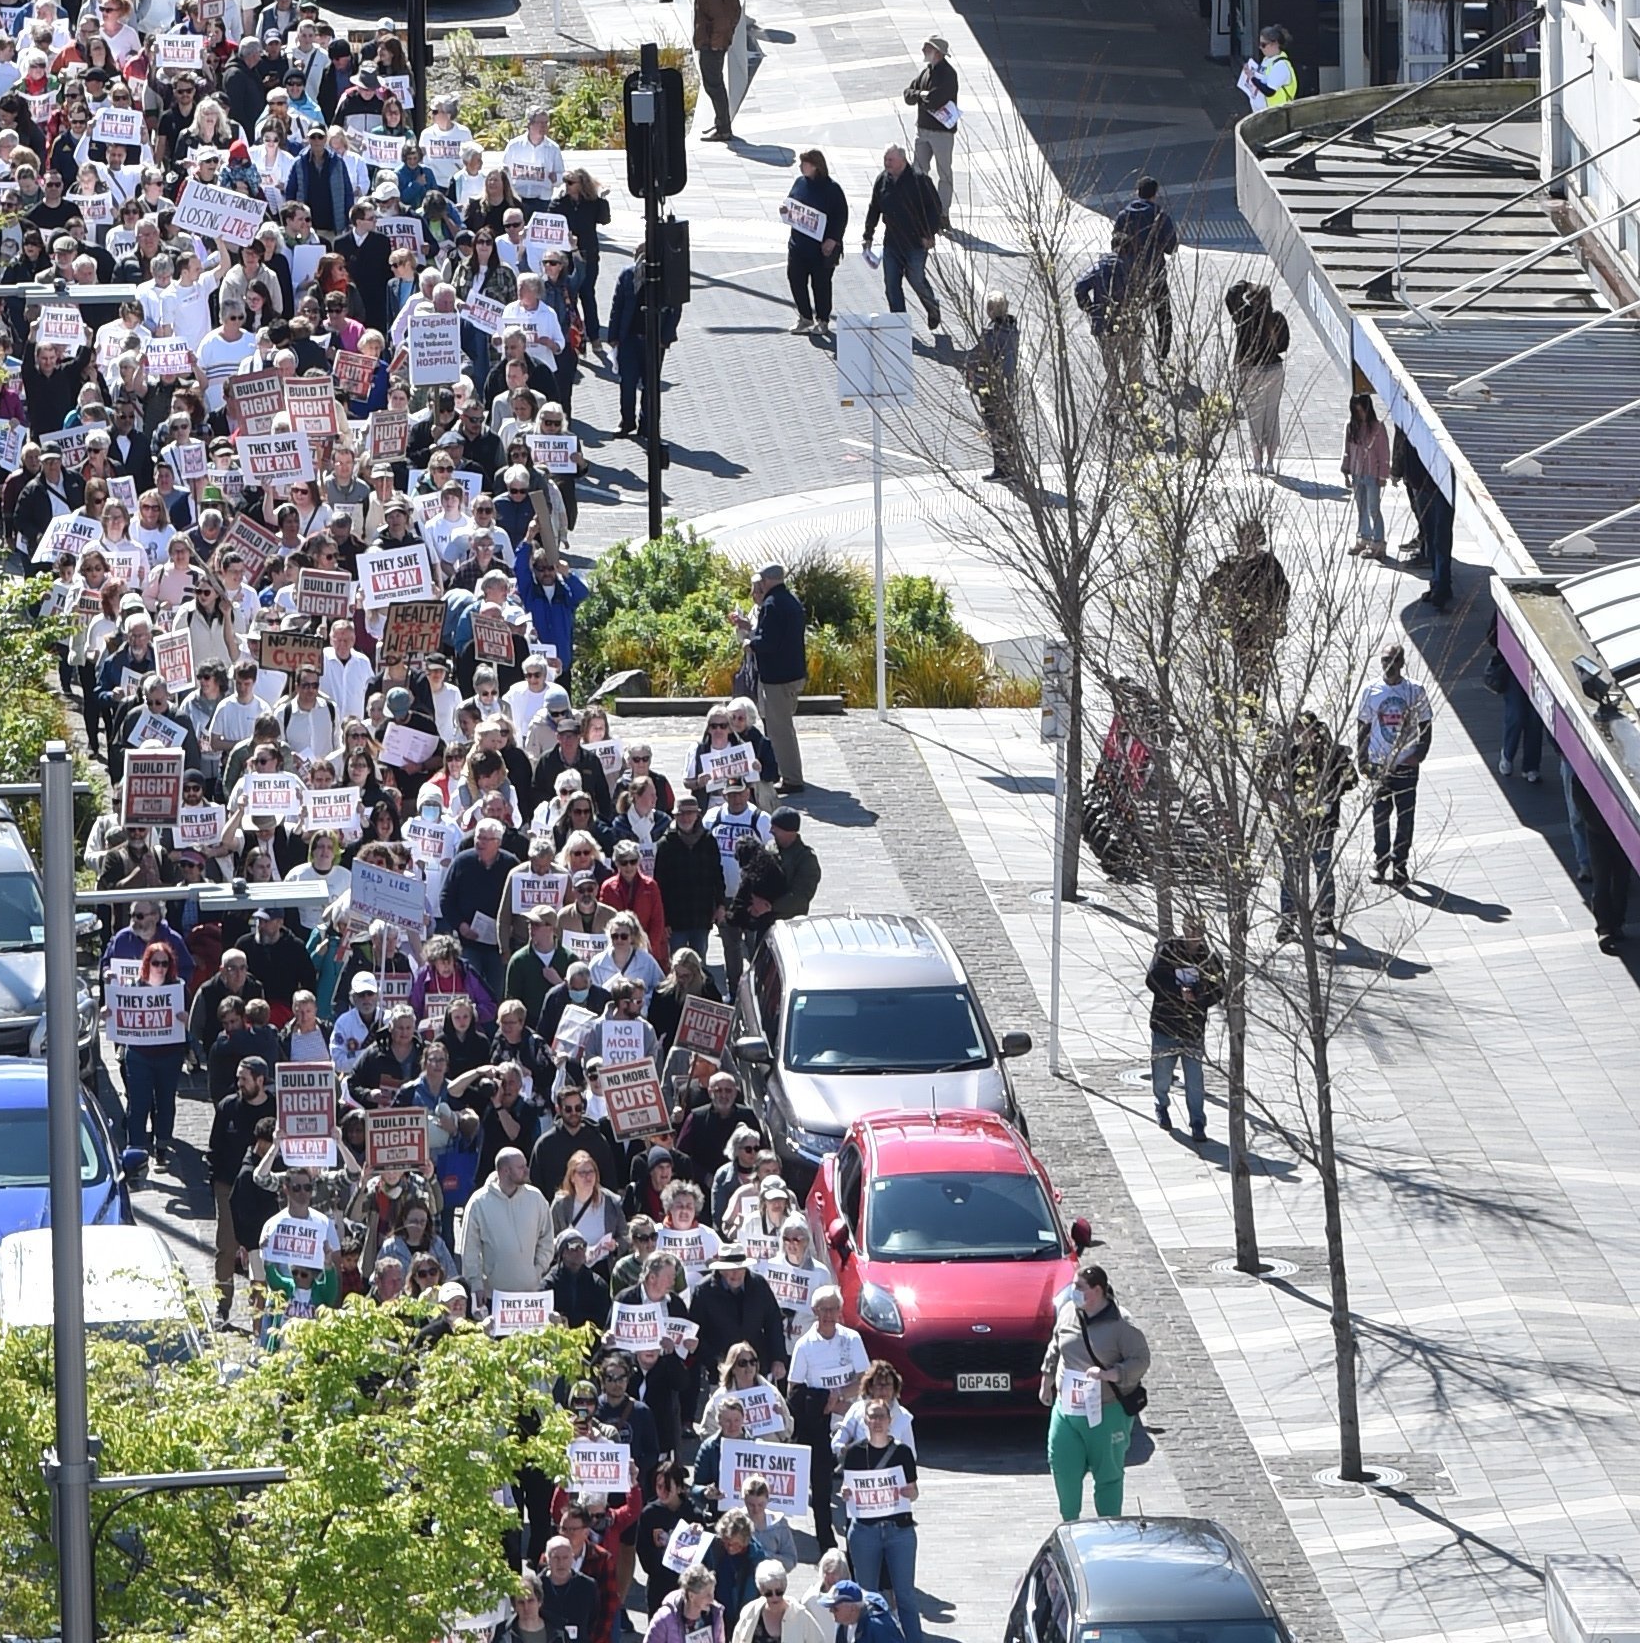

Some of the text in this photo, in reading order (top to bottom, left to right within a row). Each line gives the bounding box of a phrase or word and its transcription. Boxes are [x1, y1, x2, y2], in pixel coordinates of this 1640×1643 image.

[193, 184, 264, 215] LOSING FUNDING
[179, 205, 257, 240] LOSING LIVES
[410, 319, 420, 328] Dr
[413, 338, 453, 349] big tobacco
[423, 331, 437, 342] fully
[426, 349, 441, 357] fund
[416, 356, 458, 367] HOSPITAL
[337, 363, 371, 382] HURT
[236, 379, 277, 396] BUILD IT
[289, 385, 329, 397] BUILD IT
[239, 396, 280, 416] RIGHT
[290, 400, 331, 415] RIGHT
[375, 424, 408, 440] HURT
[247, 440, 299, 456] THEY SAVE
[235, 524, 273, 553] BUILD IT
[369, 558, 395, 572] THEY
[303, 578, 346, 593] BUILD IT
[301, 597, 346, 616] RIGHT
[394, 606, 443, 623] HEALTH
[404, 623, 423, 636] IS
[476, 629, 510, 645] HURT
[268, 635, 323, 650] NO MORE
[386, 633, 440, 653] WEALTH
[160, 647, 190, 666] HURT
[133, 762, 176, 774] BUILD IT
[131, 778, 176, 796] RIGHT
[361, 871, 410, 893] BALD LIES
[116, 993, 171, 1007] THEY SAVE
[614, 1026, 632, 1036] NO
[685, 1011, 728, 1036] HURT
[607, 1038, 640, 1049] MORE
[610, 1050, 637, 1061] CUTS
[281, 1073, 329, 1087] BUILD IT
[607, 1068, 650, 1086] NO MORE
[282, 1093, 330, 1112] RIGHT
[612, 1086, 657, 1110] CUTS
[373, 1117, 420, 1129] BUILD IT
[373, 1130, 421, 1146] RIGHT
[959, 1375, 1009, 1389] QGP463
[736, 1452, 796, 1472] THEY SAVE
